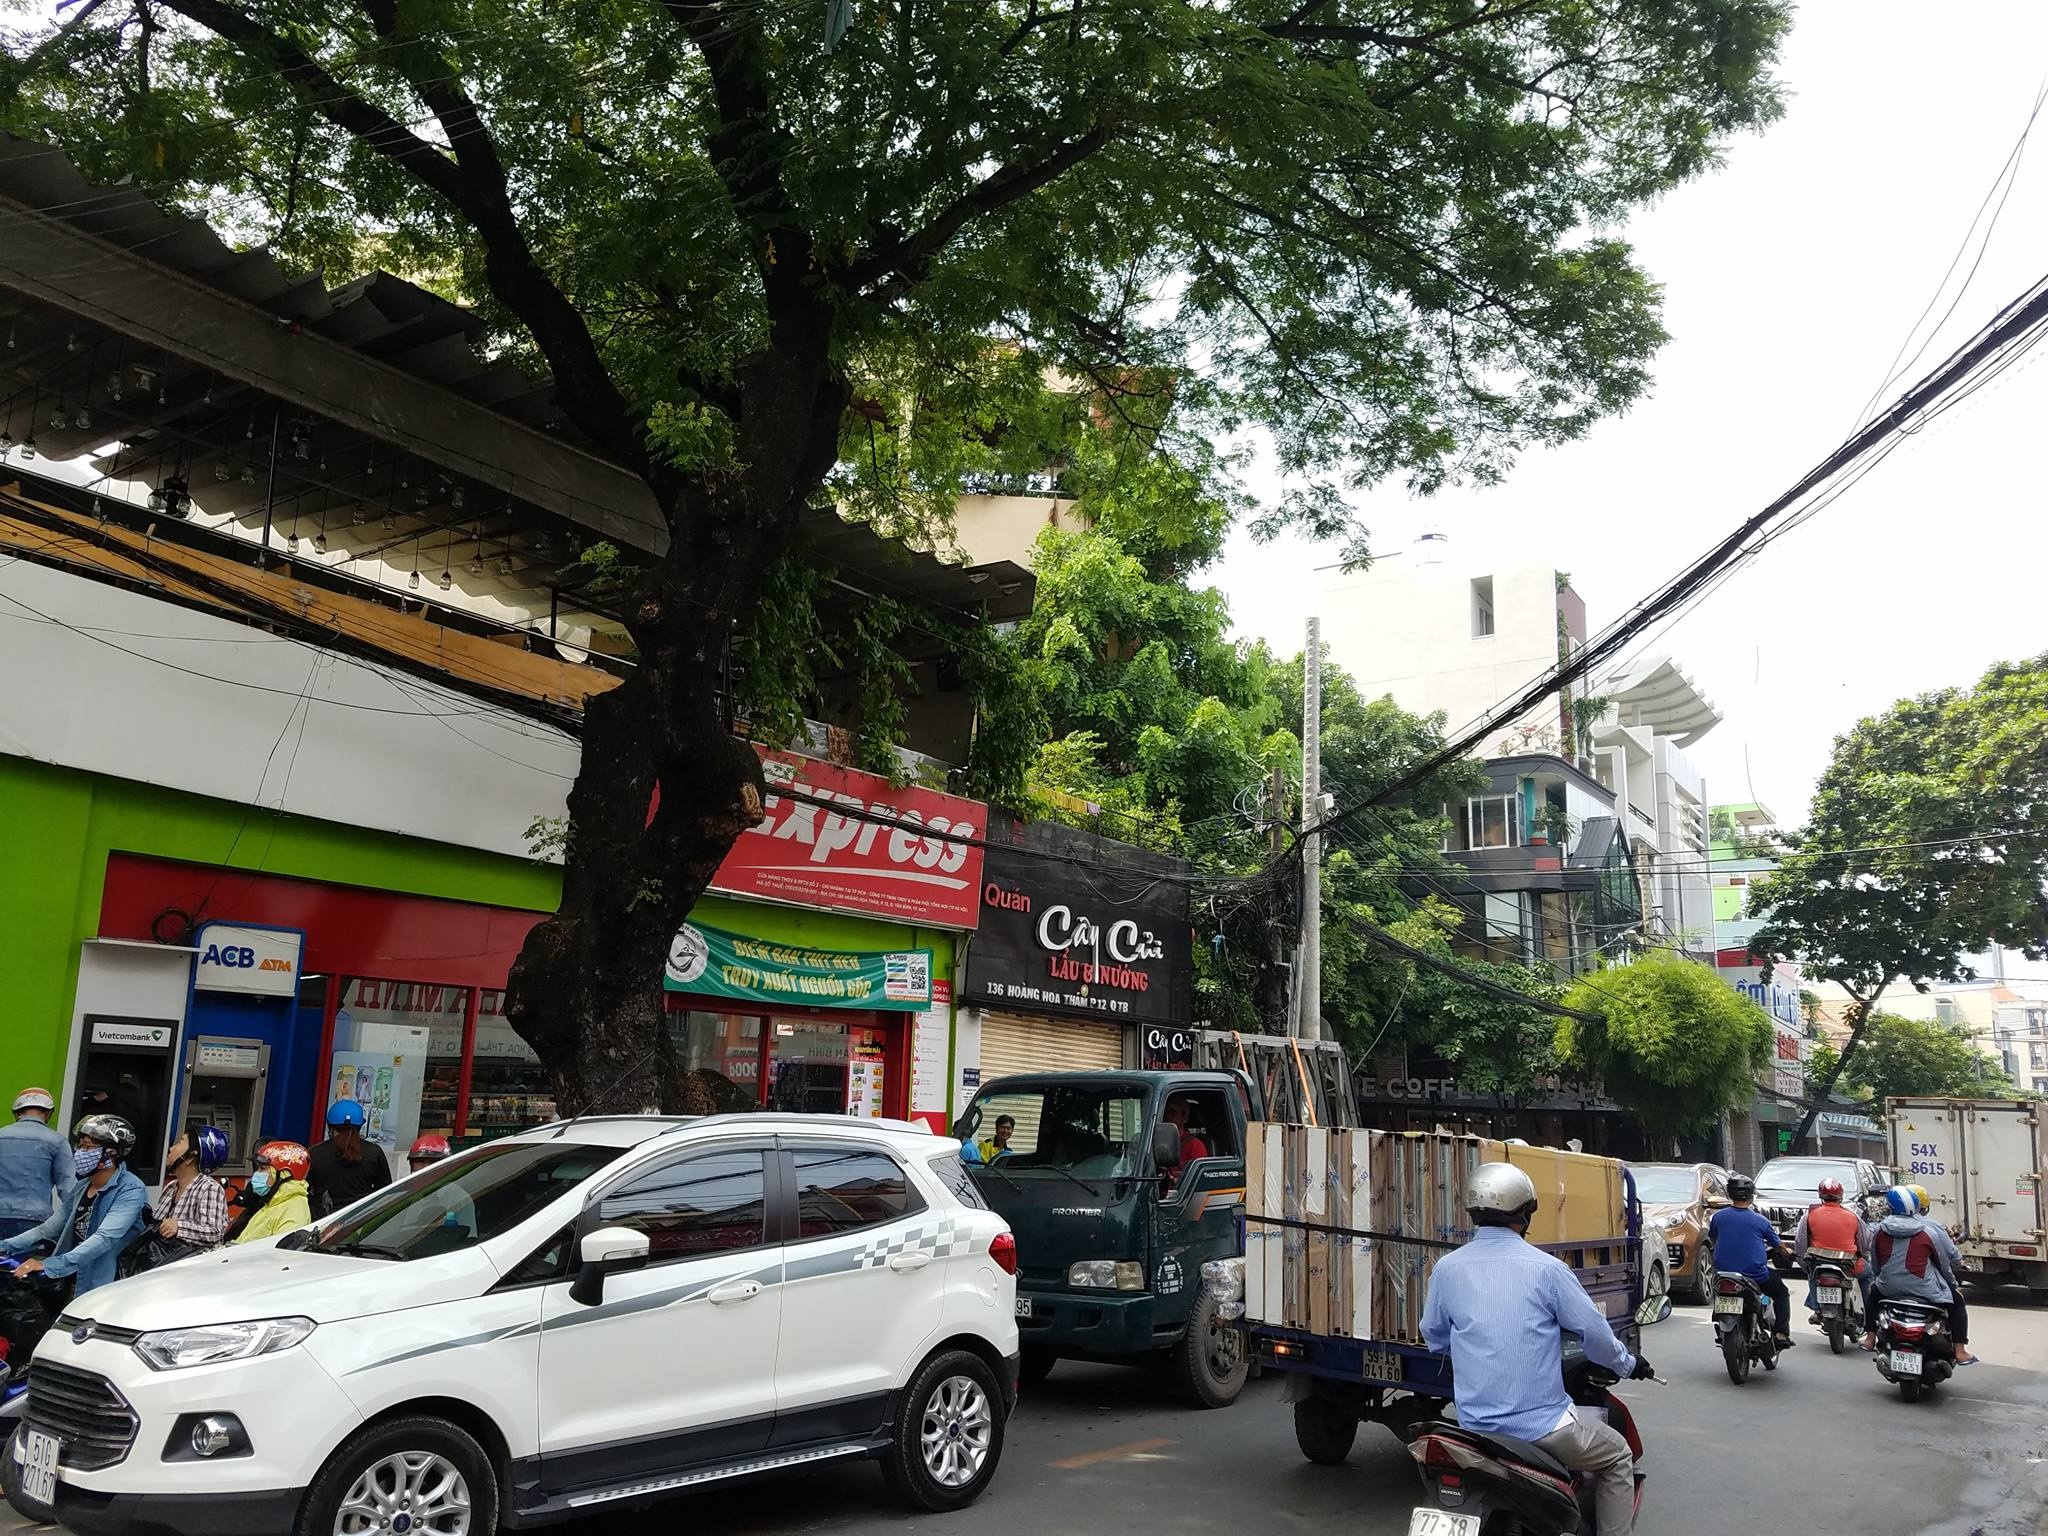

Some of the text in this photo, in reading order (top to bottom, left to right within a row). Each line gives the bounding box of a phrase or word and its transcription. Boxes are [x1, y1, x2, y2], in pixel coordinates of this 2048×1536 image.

[984, 882, 1031, 913] Quán
[1037, 905, 1164, 984] Cây Củi
[201, 944, 291, 972] ACB ATM
[833, 954, 860, 970] HEO
[1050, 948, 1079, 981] LẨU
[1100, 963, 1148, 991] NƯỚNG
[722, 965, 760, 989] TRUY
[763, 969, 798, 992] XUẤT
[800, 974, 845, 997] NGUỒN
[986, 982, 1004, 996] 136
[1007, 981, 1040, 1000] HOÀNG
[1042, 990, 1060, 1004] HOA
[98, 1031, 151, 1041] Vietcombank
[1911, 1143, 1938, 1157] 54X
[1911, 1161, 1945, 1175] 8615
[1052, 1208, 1102, 1218] FRONTIER
[33, 1435, 52, 1467] 51G
[1440, 1489, 1462, 1497] HONDA
